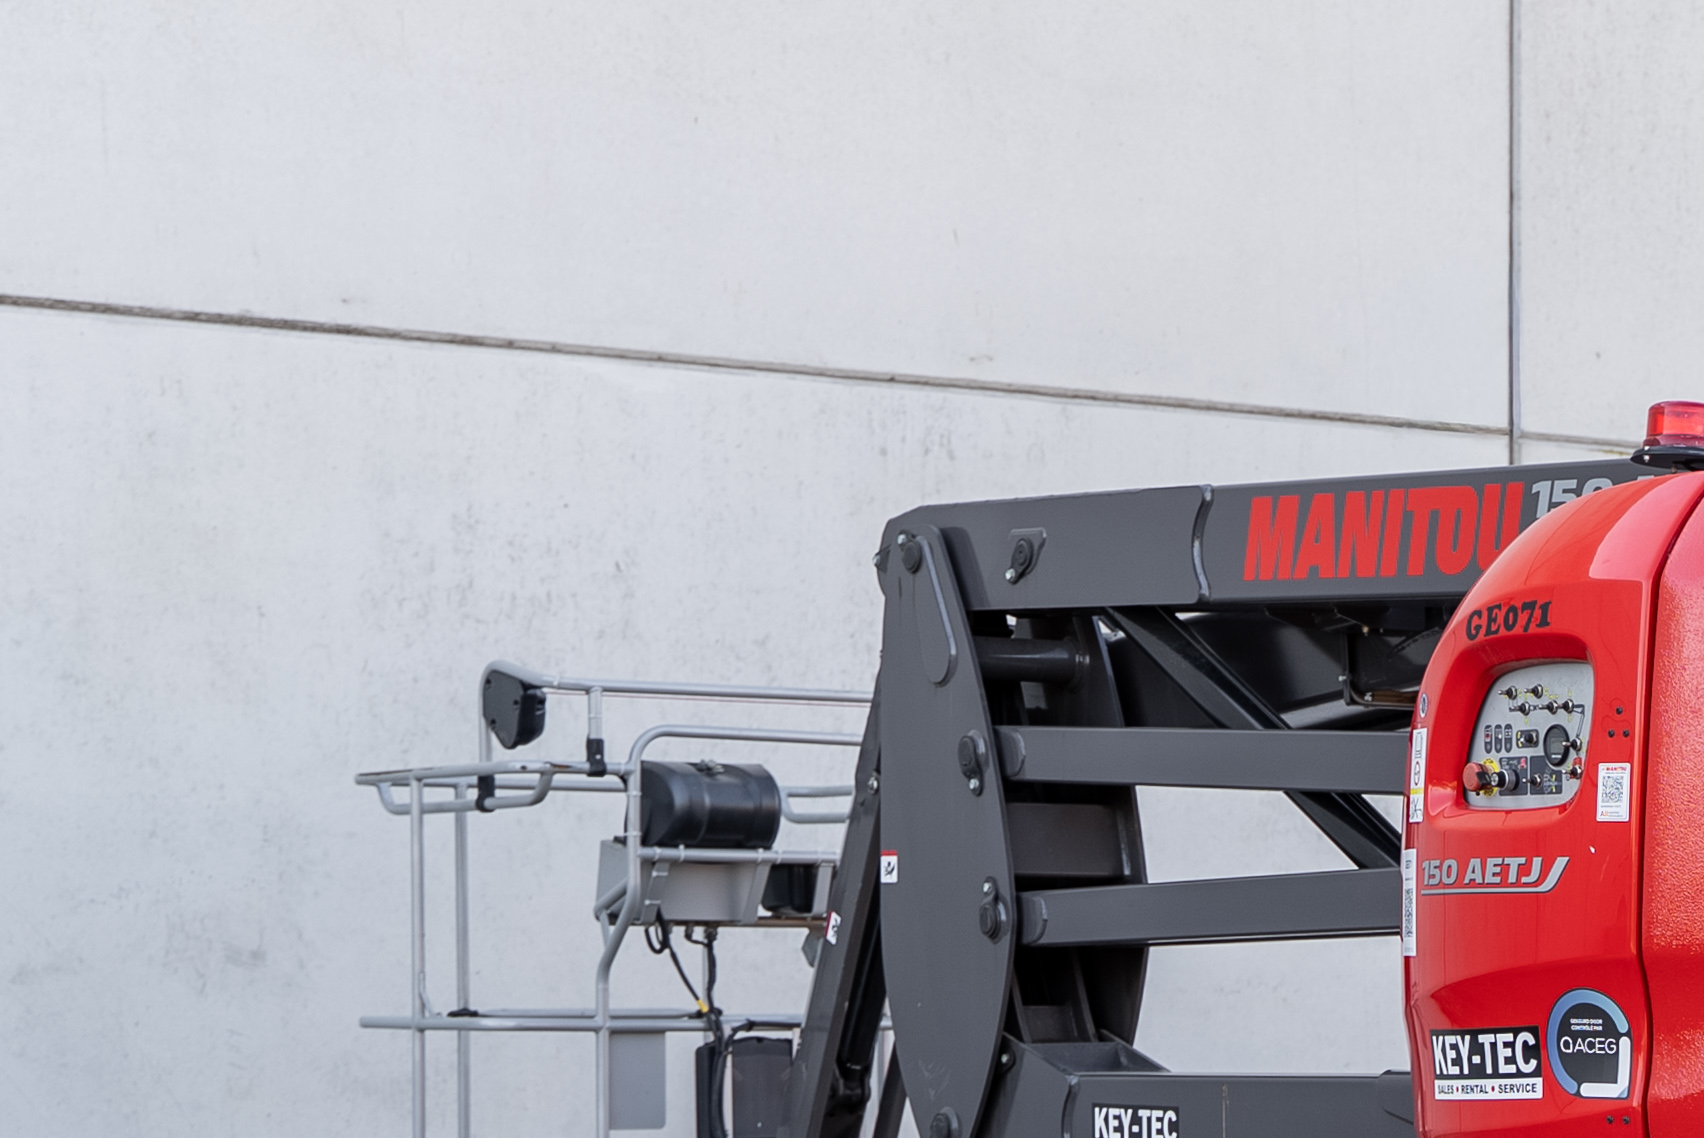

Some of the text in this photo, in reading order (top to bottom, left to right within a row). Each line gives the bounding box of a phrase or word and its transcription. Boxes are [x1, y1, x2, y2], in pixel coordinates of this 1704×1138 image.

[1243, 482, 1524, 581] MANITOU
[1466, 600, 1552, 641] GE071
[1422, 858, 1458, 886] 150
[1463, 857, 1543, 885] AETJ
[1432, 1032, 1538, 1075] KEY-TEC
[1438, 1083, 1538, 1094] SALES RENTAL SERVICE
